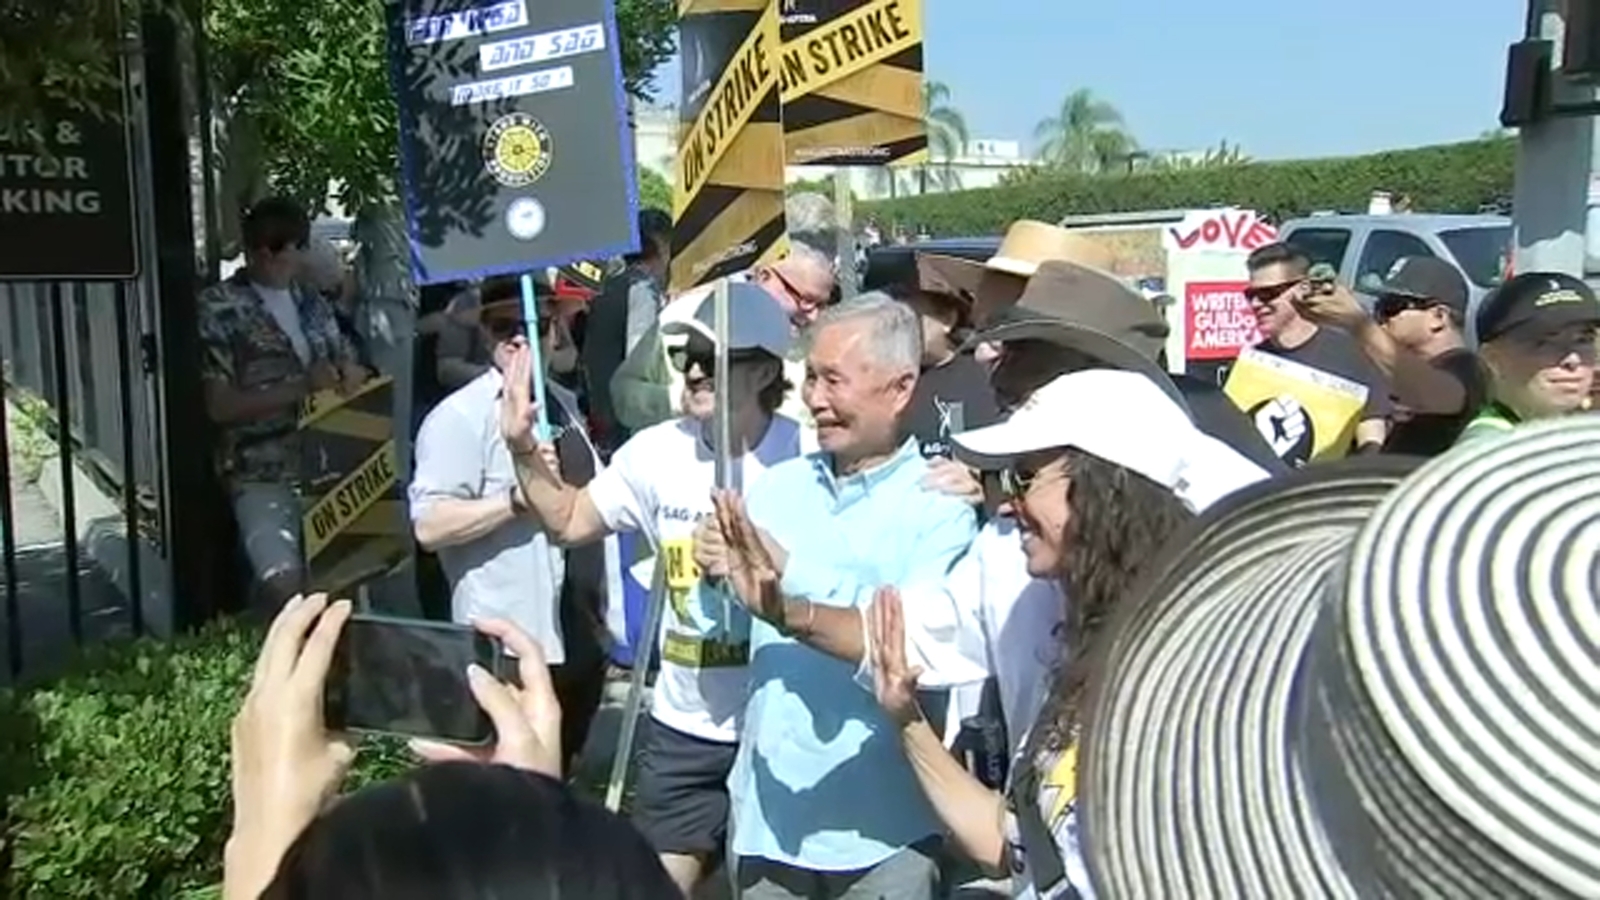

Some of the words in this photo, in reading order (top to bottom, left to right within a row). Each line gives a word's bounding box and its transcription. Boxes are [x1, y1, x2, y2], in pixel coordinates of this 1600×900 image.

[488, 39, 536, 66] AND
[547, 28, 598, 56] SAG
[808, 2, 910, 75] STRIKE
[529, 74, 552, 91] SO
[683, 130, 705, 193] ON
[704, 33, 770, 155] STRIKE
[55, 119, 82, 144] &
[0, 188, 101, 213] KING
[1169, 213, 1277, 250] LOVE
[1194, 311, 1244, 331] GUILD
[1191, 328, 1264, 349] AMERICA
[312, 501, 339, 539] ON
[335, 452, 394, 517] STRIKE
